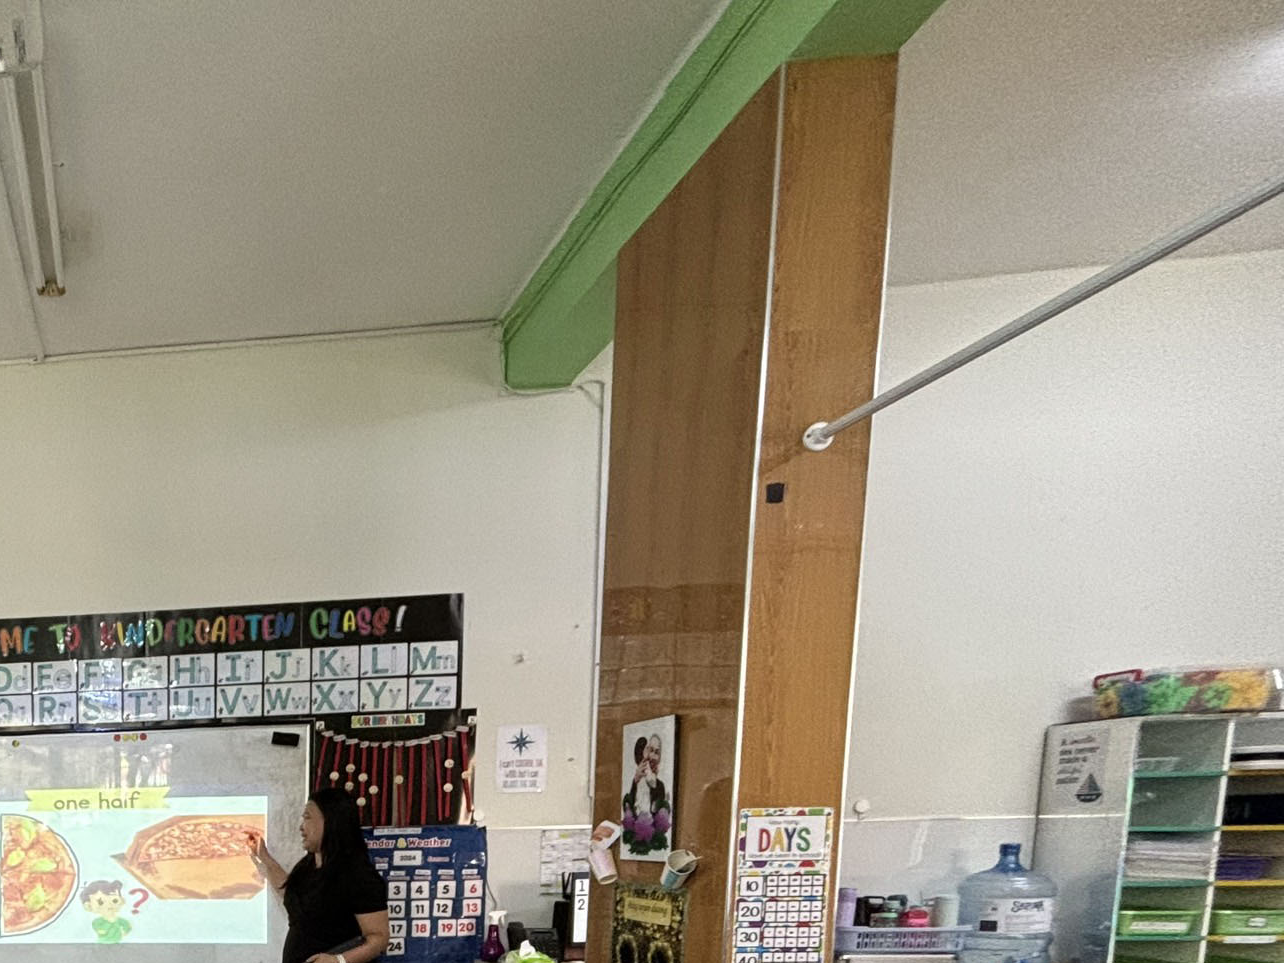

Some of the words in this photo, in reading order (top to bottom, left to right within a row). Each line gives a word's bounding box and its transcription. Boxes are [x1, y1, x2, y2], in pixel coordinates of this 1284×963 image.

[48, 623, 81, 654] TO
[99, 611, 296, 651] KINDERGARTEN
[309, 604, 407, 640] CLASS!
[174, 656, 211, 685] Hh
[270, 651, 303, 680] Jj
[318, 648, 350, 677] Kk
[412, 645, 456, 672] Mm
[173, 689, 211, 717] Uu
[220, 687, 260, 715] Vv
[266, 686, 310, 712] Ww
[316, 683, 357, 712] Xx
[367, 681, 403, 709] Yy
[415, 678, 453, 708] Zz
[53, 797, 91, 811] one
[98, 791, 142, 809] half
[364, 838, 396, 848] endar
[407, 837, 451, 848] Weather
[758, 827, 812, 852] DAYS
[393, 885, 401, 895] 3
[415, 885, 423, 895] 4
[442, 885, 450, 894] 5
[469, 884, 477, 893] 6
[579, 880, 586, 892] 1
[746, 880, 759, 892] 10
[389, 904, 402, 914] 10
[416, 905, 424, 914] 11
[436, 904, 448, 913] 12
[466, 903, 478, 913] 13
[577, 898, 586, 911] 2
[740, 906, 760, 918] 20
[391, 924, 403, 934] 17
[414, 924, 427, 933] 18
[441, 923, 453, 933] 19
[459, 922, 474, 932] 20
[739, 931, 758, 943] 30
[388, 942, 402, 951] 24
